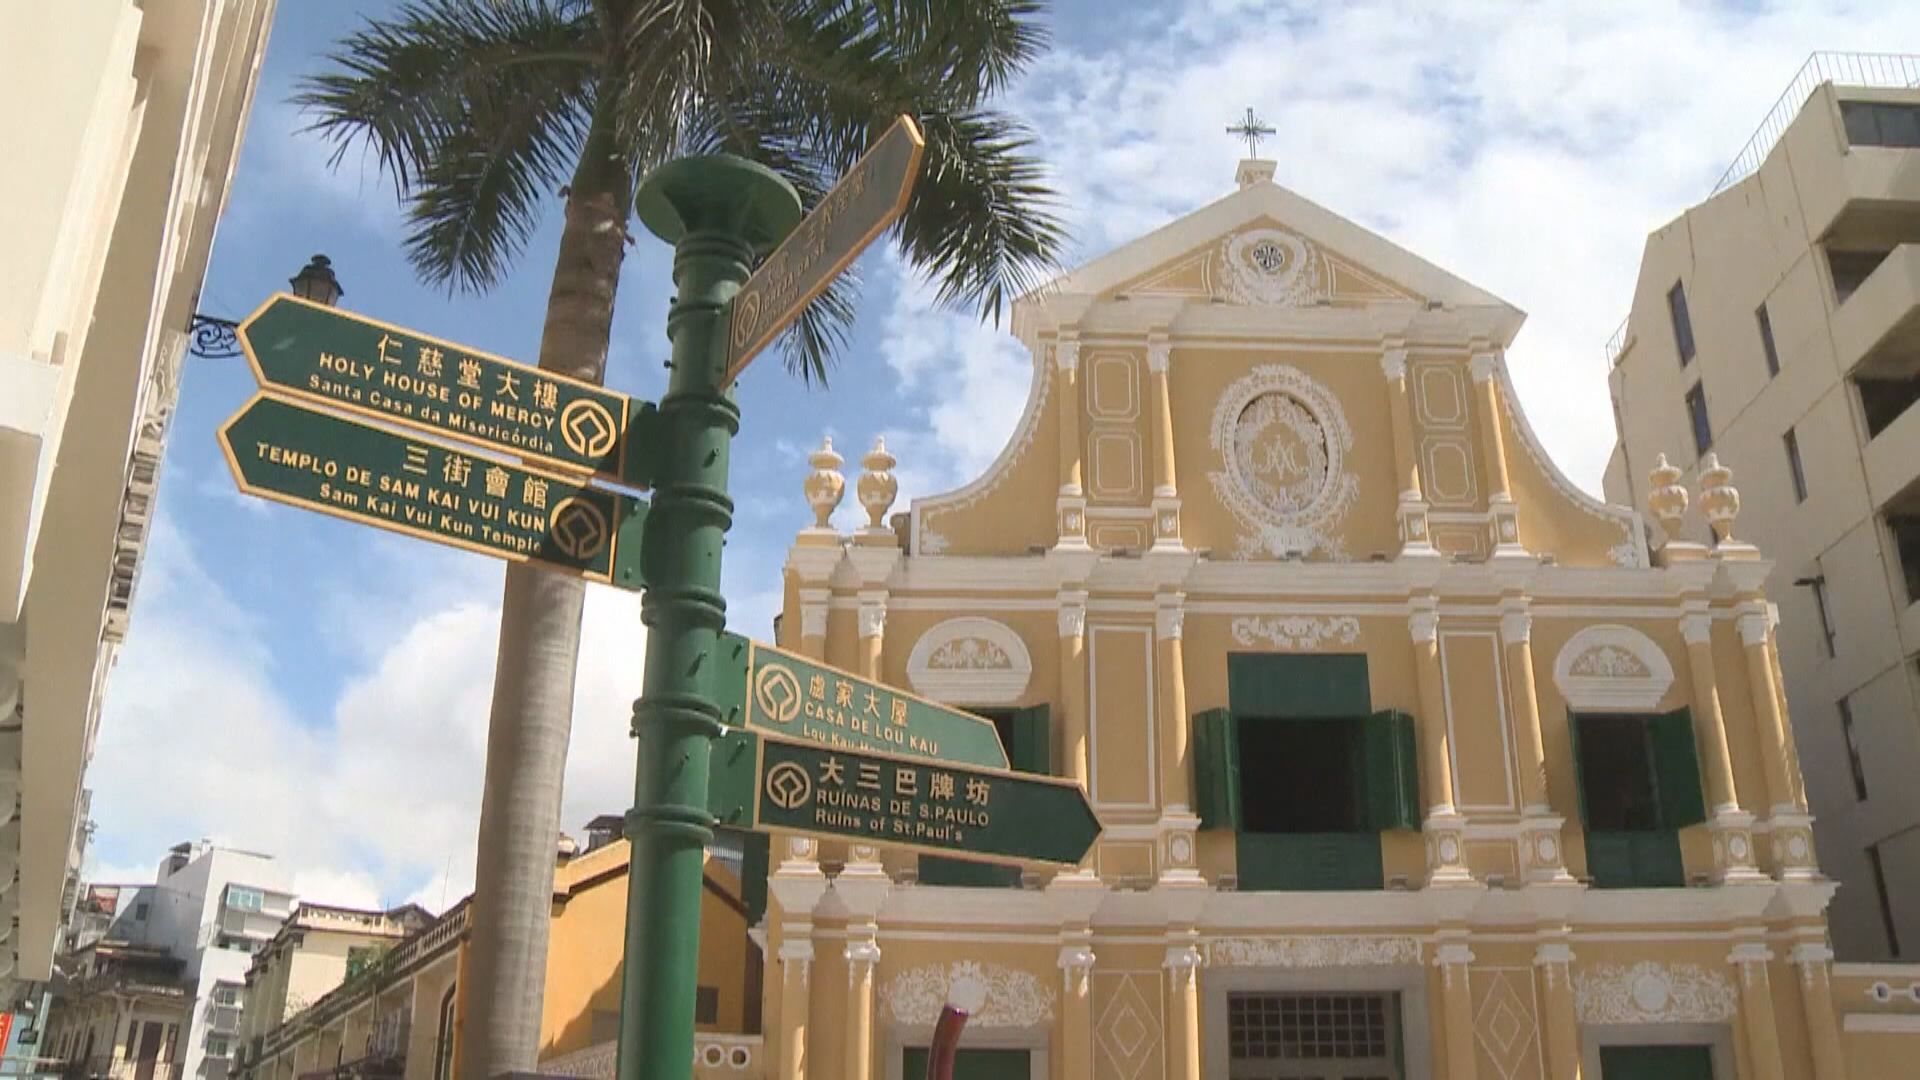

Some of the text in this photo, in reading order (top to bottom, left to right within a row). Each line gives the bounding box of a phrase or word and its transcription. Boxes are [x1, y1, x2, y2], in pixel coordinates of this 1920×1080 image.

[319, 351, 555, 433] HOLY HOUSE OF MERCY
[378, 333, 559, 412] 仁慈堂大樓
[309, 374, 553, 454] Santa Casa da Misericórdia
[256, 440, 545, 534] TEMPLO DE SAM KAI VUI KUN
[402, 443, 549, 511] 三街會館
[319, 481, 359, 507] Sam
[366, 494, 397, 518] Kai
[404, 505, 433, 526] Vui
[440, 513, 474, 537] Kun
[803, 721, 826, 743] Lou
[804, 700, 845, 727] CASA
[851, 714, 869, 736] DE
[875, 723, 904, 745] LOU
[909, 734, 938, 756] KAU
[819, 756, 991, 807] 大三巴牌坊
[815, 807, 963, 842] Ruins of St.Paul's
[890, 799, 912, 817] DE
[919, 803, 989, 828] S.PAULO
